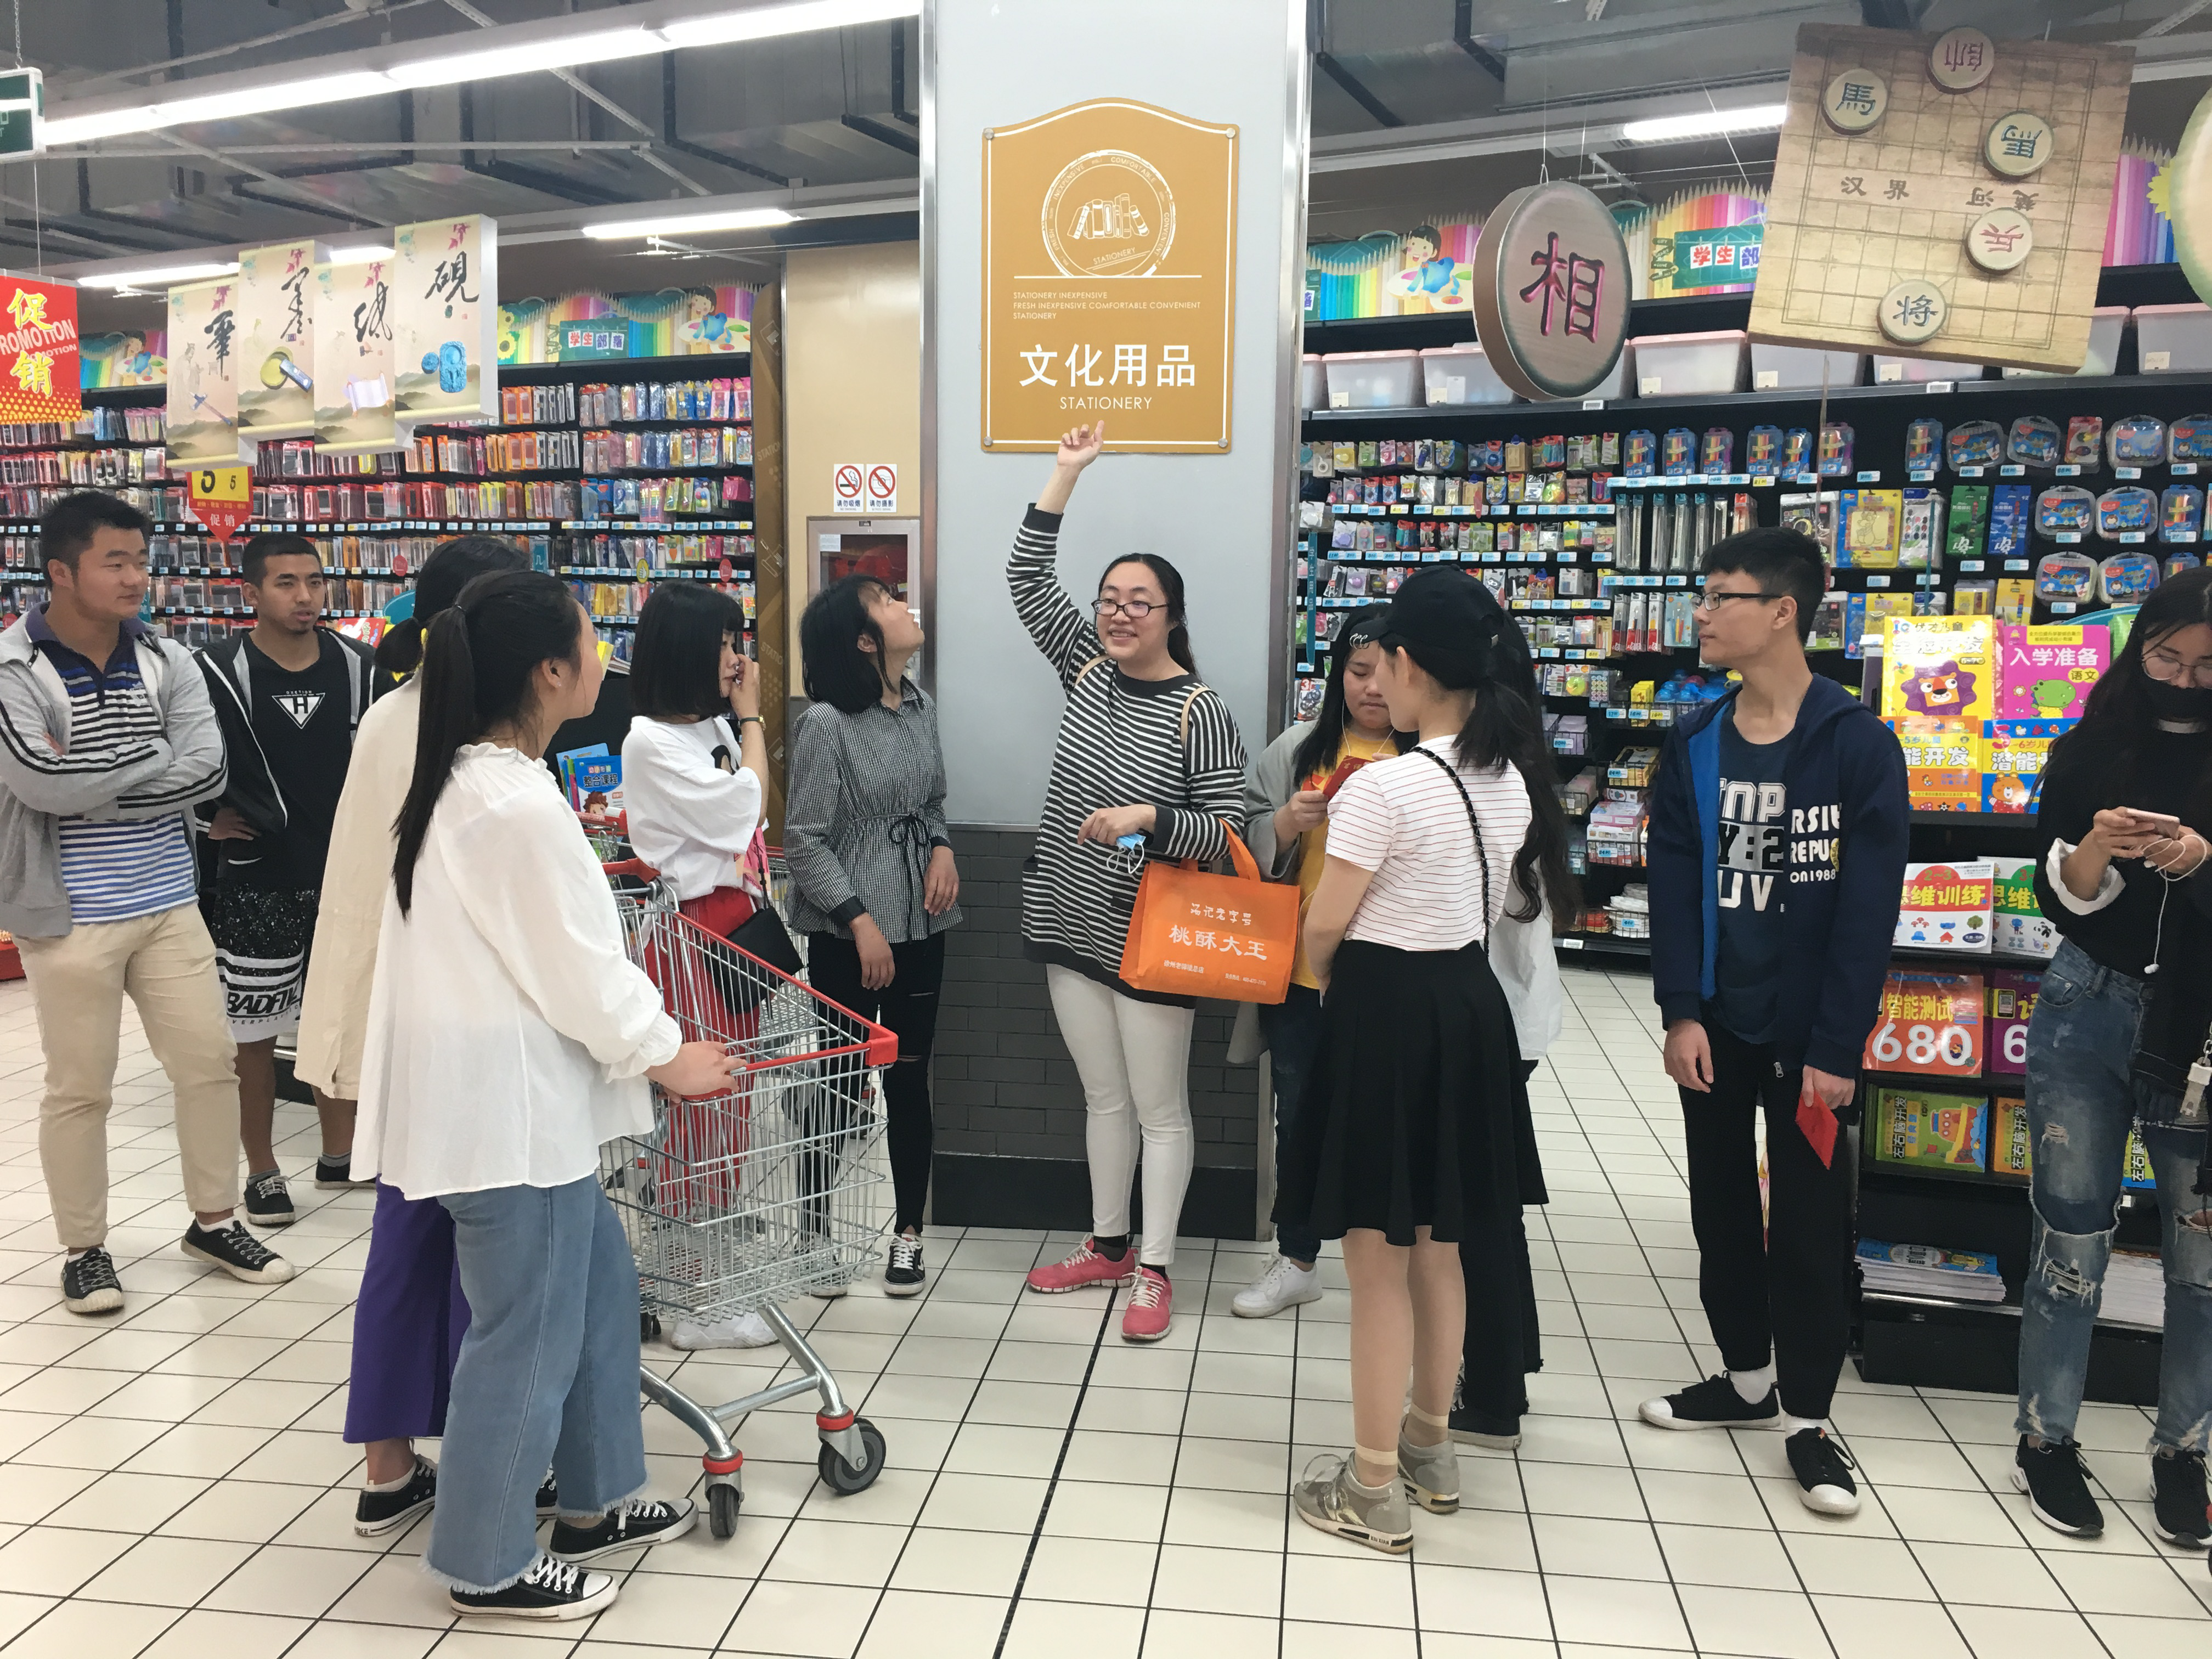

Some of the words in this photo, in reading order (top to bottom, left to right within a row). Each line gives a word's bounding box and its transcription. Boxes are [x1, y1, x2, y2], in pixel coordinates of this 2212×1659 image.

[1053, 163, 1085, 201] INEXPENSIVE
[1111, 156, 1156, 183] COMFORTABLE
[1841, 176, 1910, 201] 汉界
[1048, 228, 1060, 251] FRESH
[1154, 212, 1170, 256] CONVENIENT
[1093, 247, 1136, 265] STATIONERY
[1519, 231, 1605, 343] 相
[0, 318, 76, 356] ROMOTION
[569, 331, 623, 350] 学生部落
[1019, 343, 1195, 387] 文化用品
[1060, 396, 1152, 410] STATIONERY
[210, 514, 235, 527] 促销
[2010, 647, 2098, 667] 入学准备
[2071, 670, 2096, 681] 语文
[1904, 747, 1970, 766] 能开发
[583, 774, 618, 787] 整合课程
[1169, 924, 1267, 961] 桃酥大王
[1886, 992, 1954, 1022] 智能测试
[1872, 1023, 1973, 1066] 680
[1893, 1096, 1907, 1159] 左右脑开发
[2012, 1105, 2027, 1170] 左右脑开发
